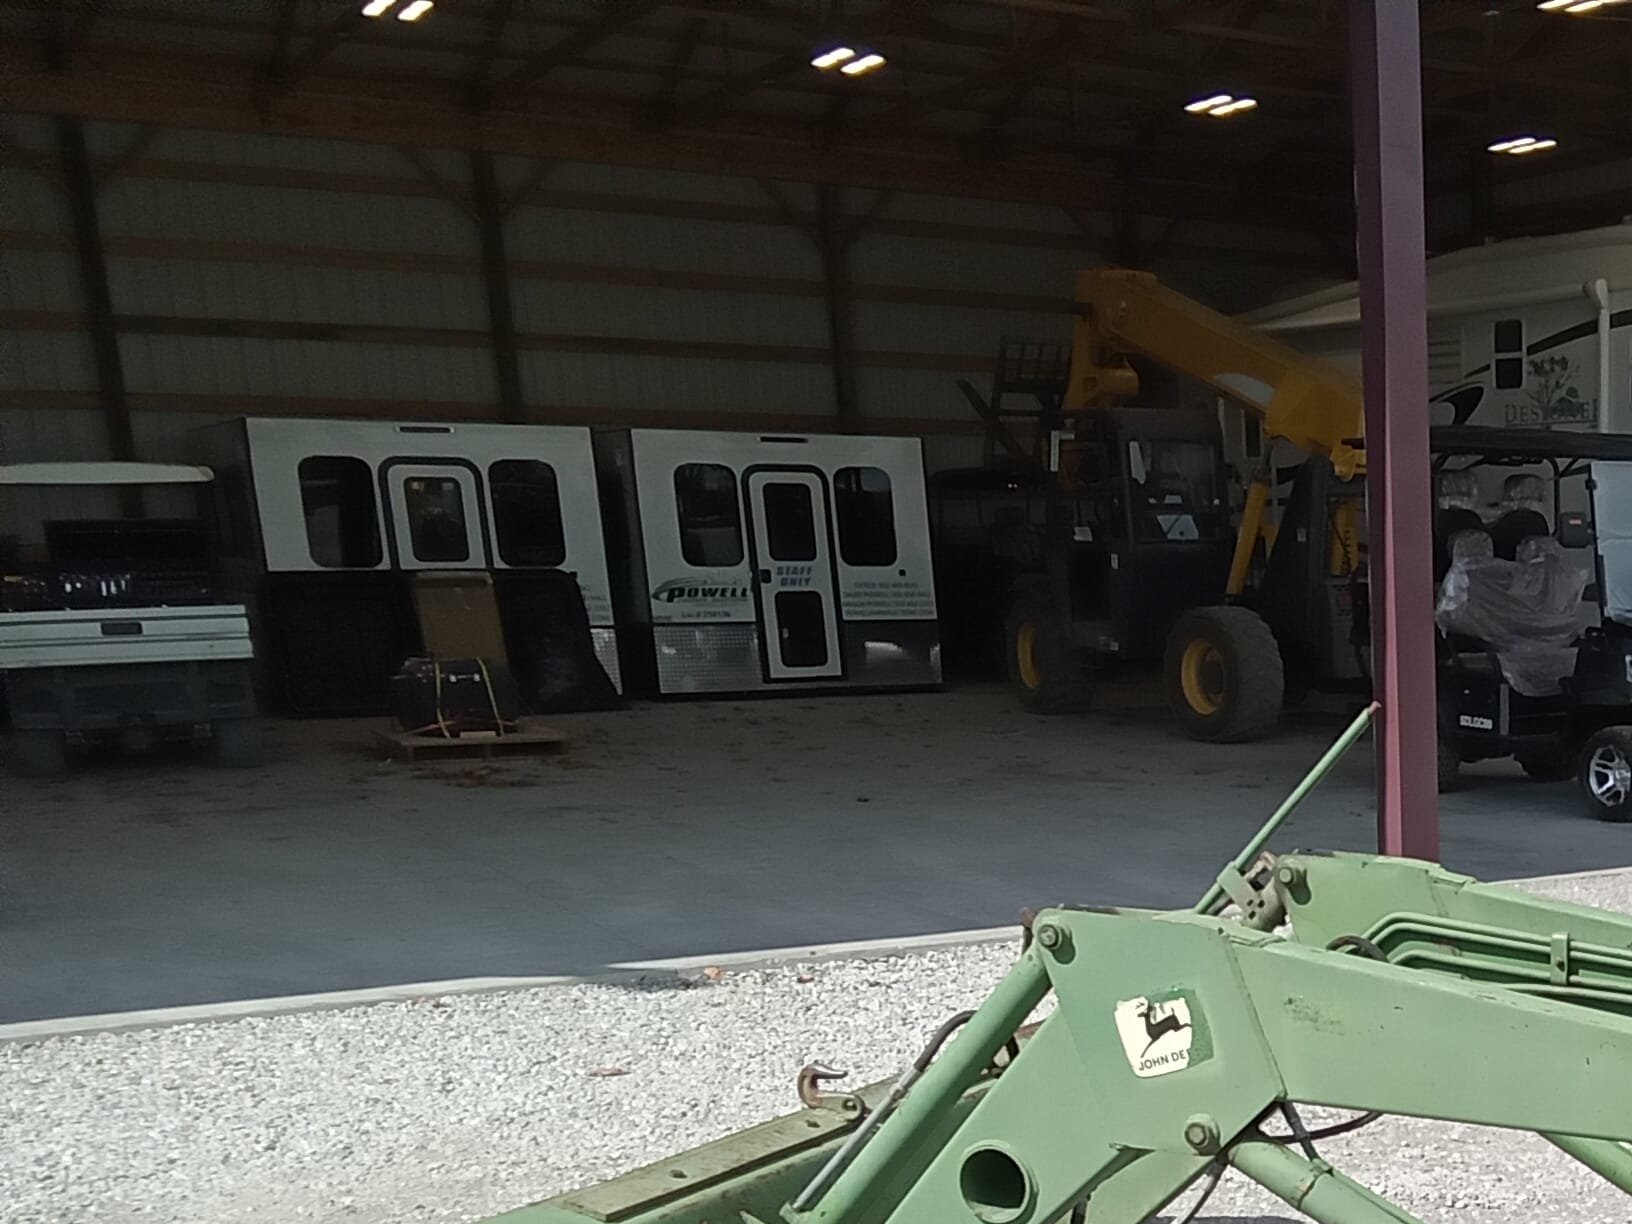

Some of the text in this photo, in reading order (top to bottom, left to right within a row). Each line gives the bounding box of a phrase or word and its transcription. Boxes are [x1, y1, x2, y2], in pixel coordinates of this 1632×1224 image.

[1505, 399, 1599, 423] DESNE
[666, 586, 748, 603] POWELL
[1138, 1055, 1169, 1071] JOHN
